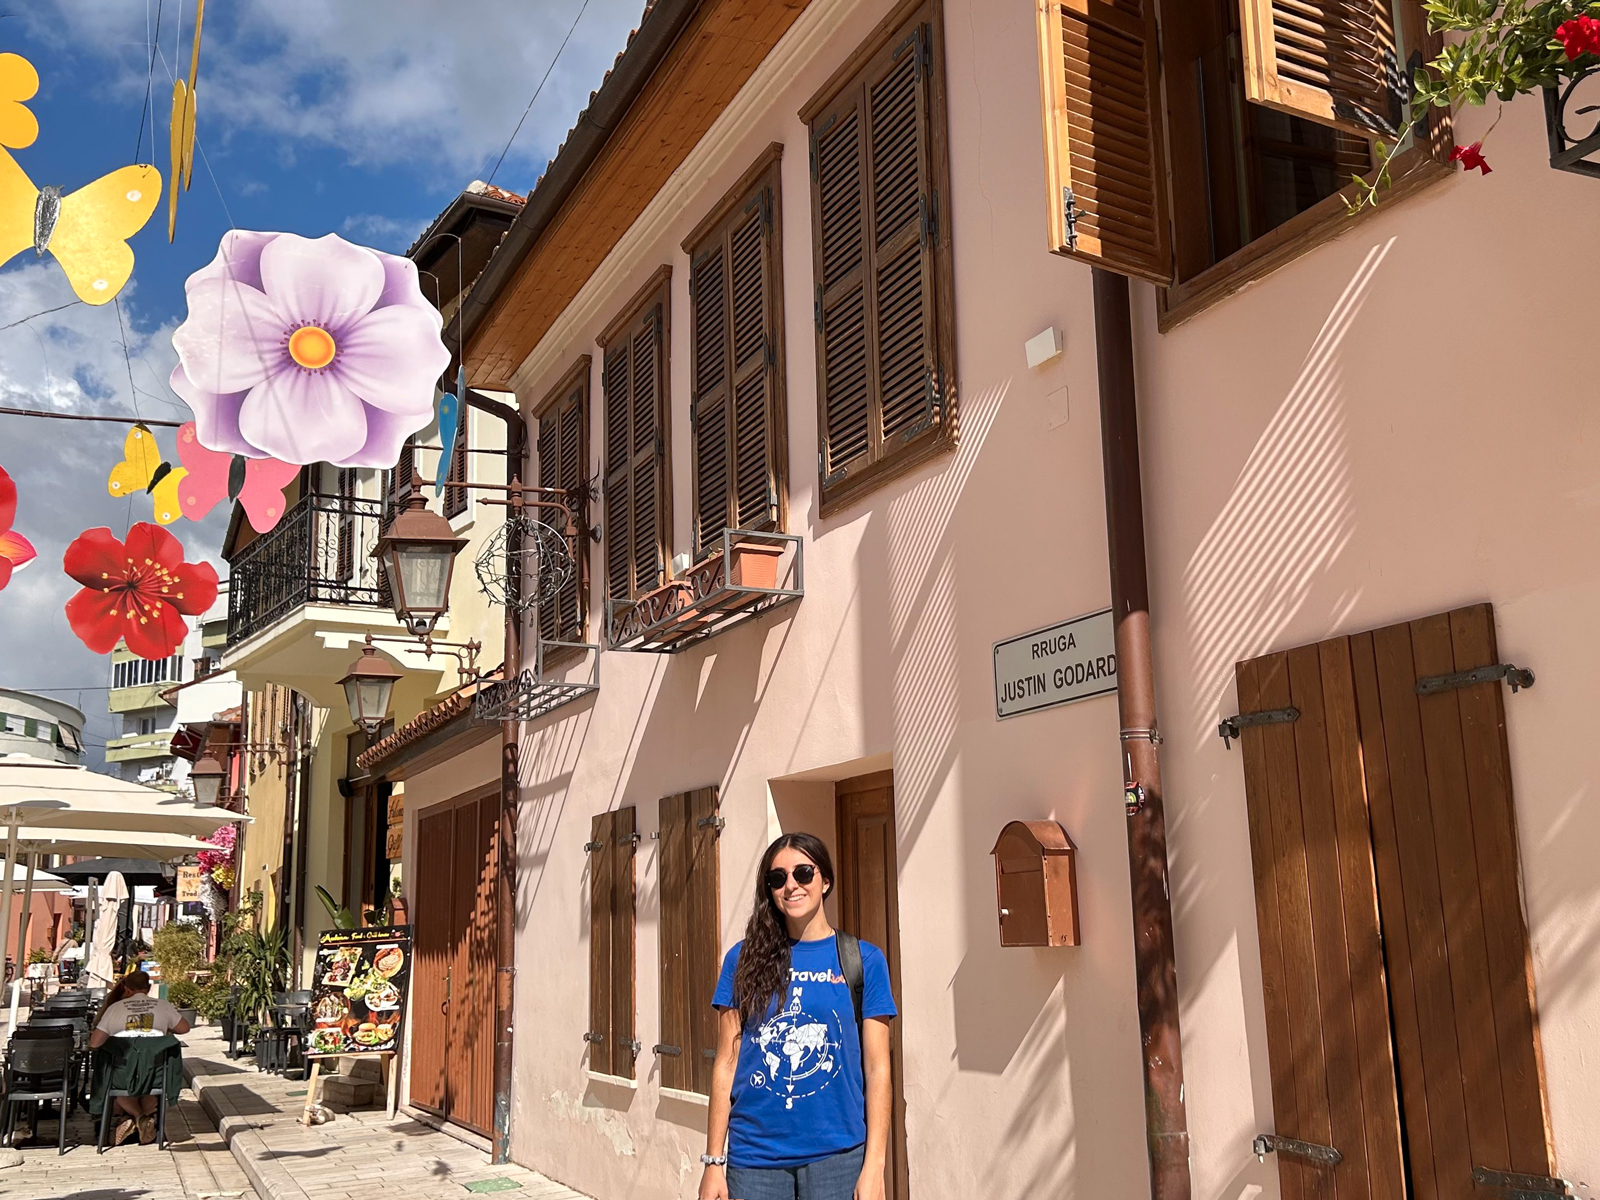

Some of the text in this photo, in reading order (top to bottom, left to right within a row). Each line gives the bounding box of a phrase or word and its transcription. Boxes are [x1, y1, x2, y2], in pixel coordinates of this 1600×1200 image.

[1031, 633, 1076, 660] RRUGA
[1001, 654, 1117, 703] JUSTIN GODARD
[793, 987, 802, 996] N
[785, 1097, 793, 1109] S
